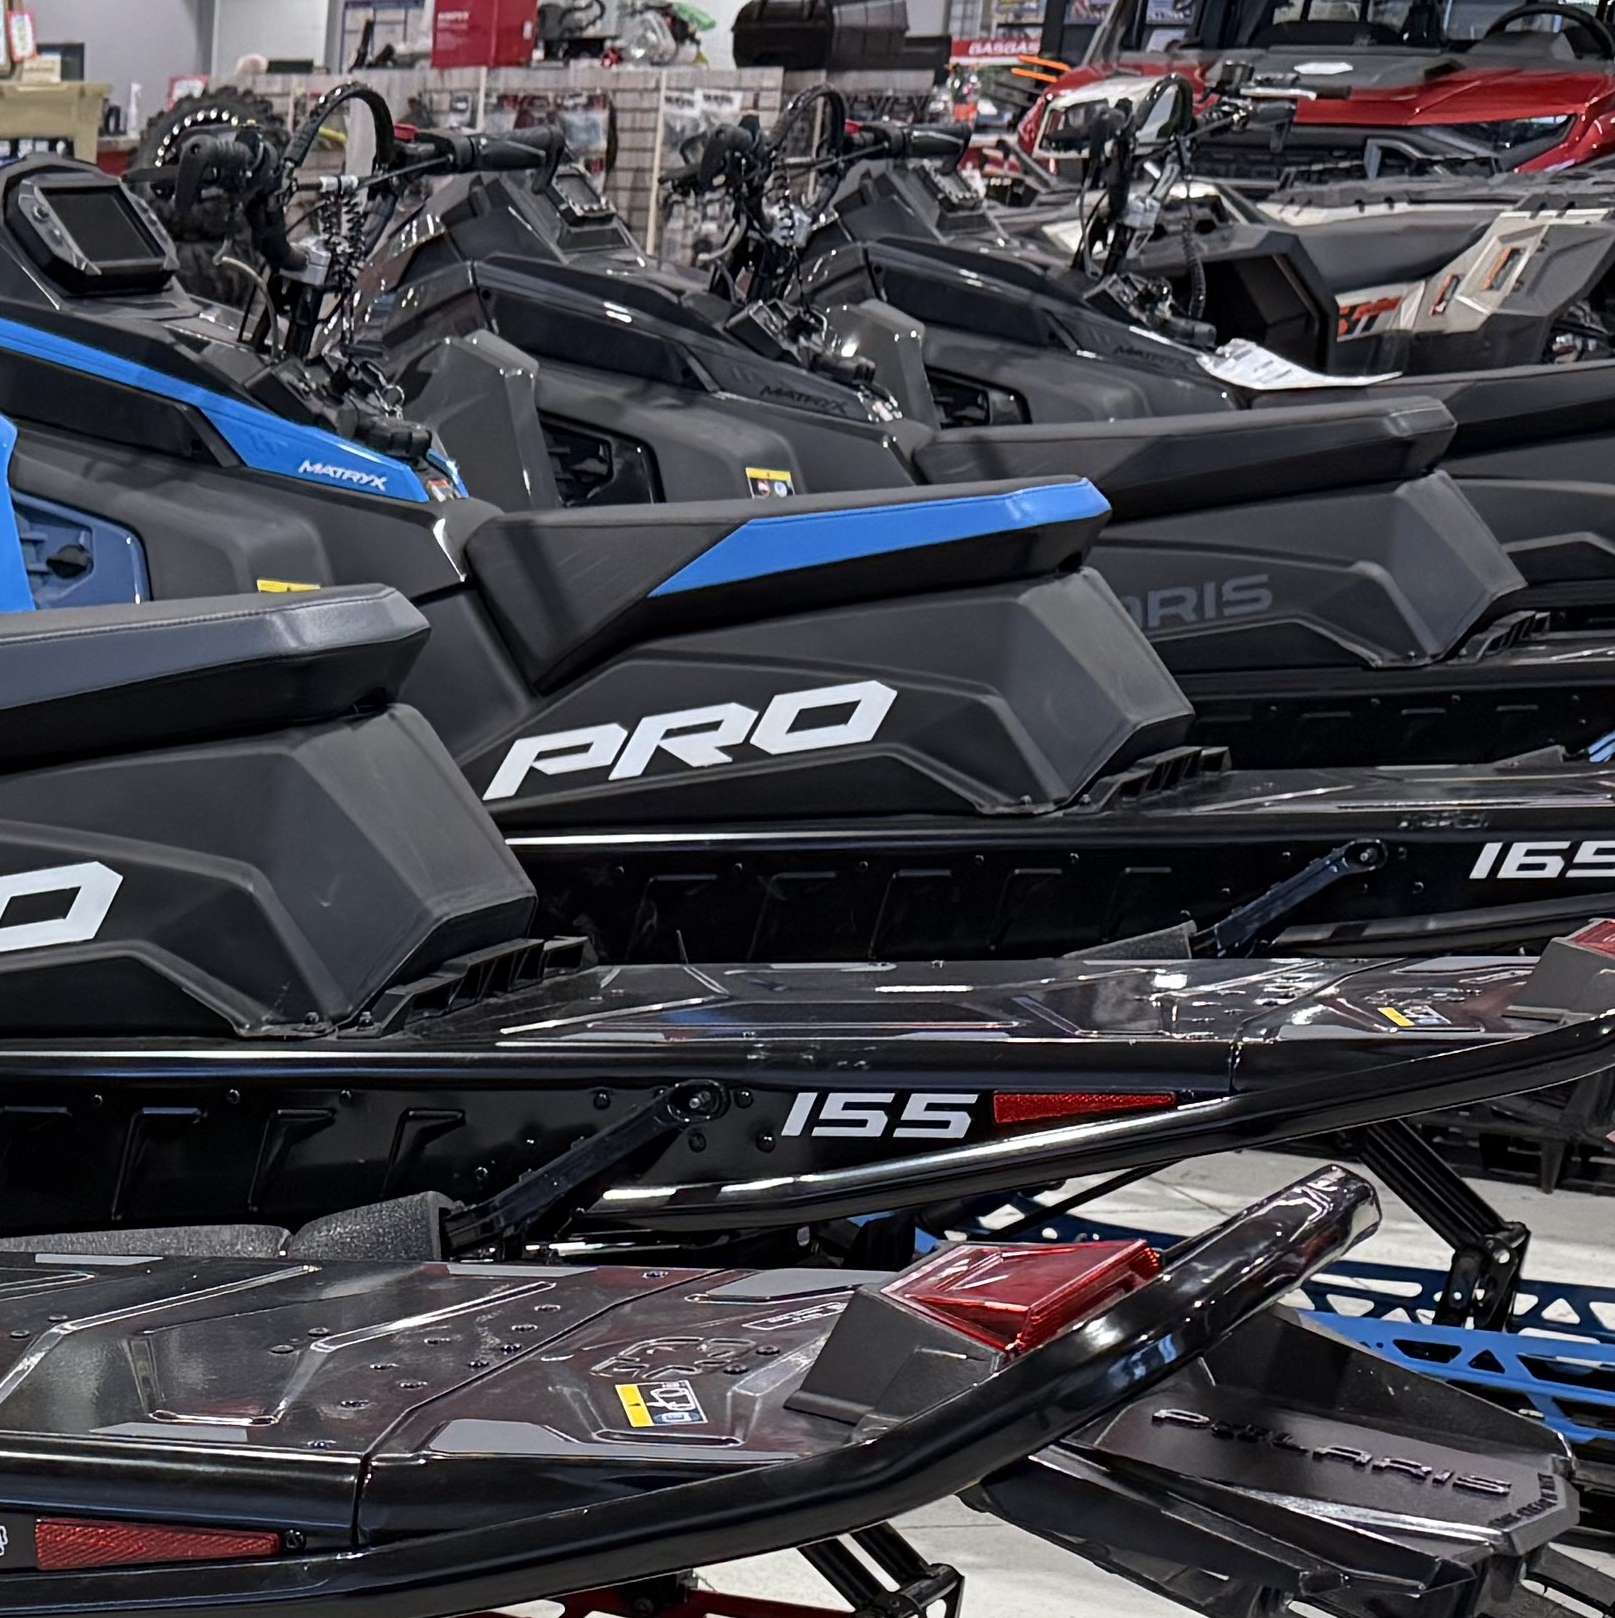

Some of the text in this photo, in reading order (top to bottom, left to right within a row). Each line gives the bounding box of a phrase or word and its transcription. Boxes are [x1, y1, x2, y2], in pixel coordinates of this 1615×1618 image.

[969, 41, 1040, 55] GASGAS
[298, 459, 388, 492] MATRYX
[482, 680, 898, 801] PRO
[1469, 840, 1615, 880] 165
[780, 1091, 981, 1139] 155
[1151, 1407, 1512, 1497] POLARIS
